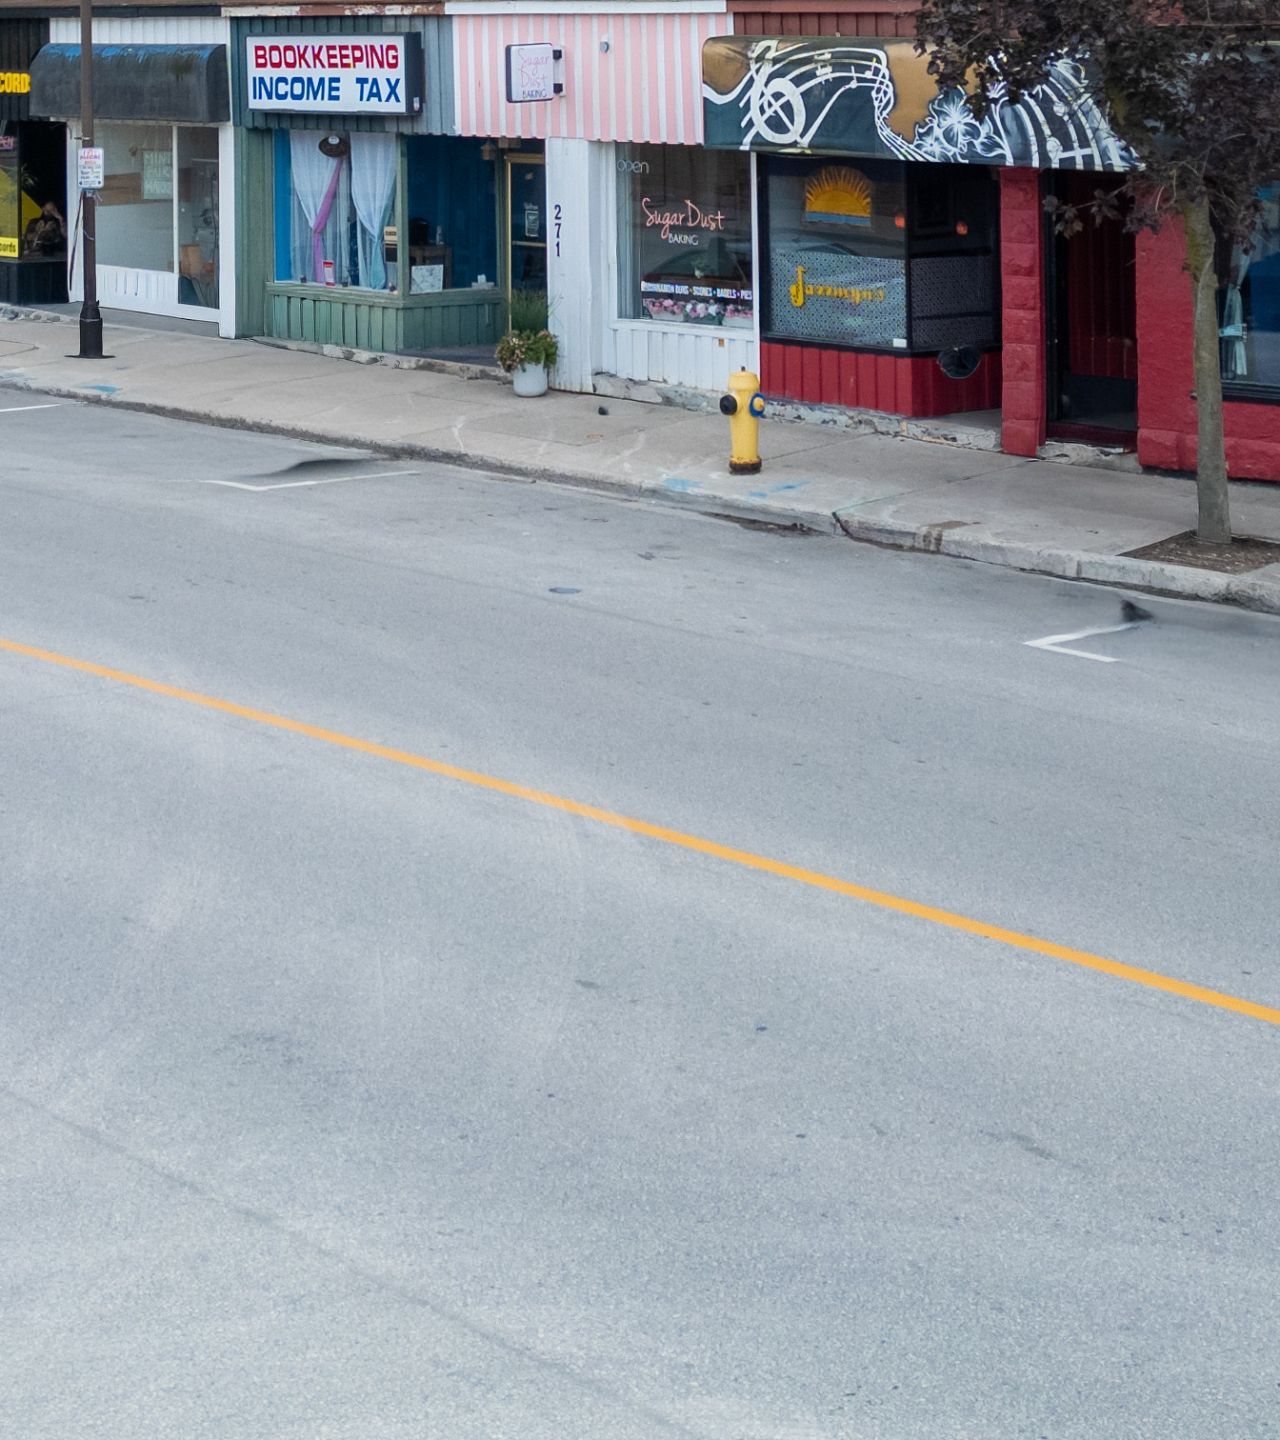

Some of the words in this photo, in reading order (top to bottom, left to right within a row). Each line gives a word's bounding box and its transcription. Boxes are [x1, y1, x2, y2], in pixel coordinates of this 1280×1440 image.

[254, 44, 399, 70] BOOKKEEPING
[252, 76, 341, 101] INCOME
[355, 77, 401, 103] TAX
[522, 89, 548, 100] BAKING
[617, 160, 649, 174] open
[554, 204, 562, 258] 271
[642, 197, 684, 239] Sugar
[684, 199, 725, 230] Dust
[668, 232, 699, 245] BAKING
